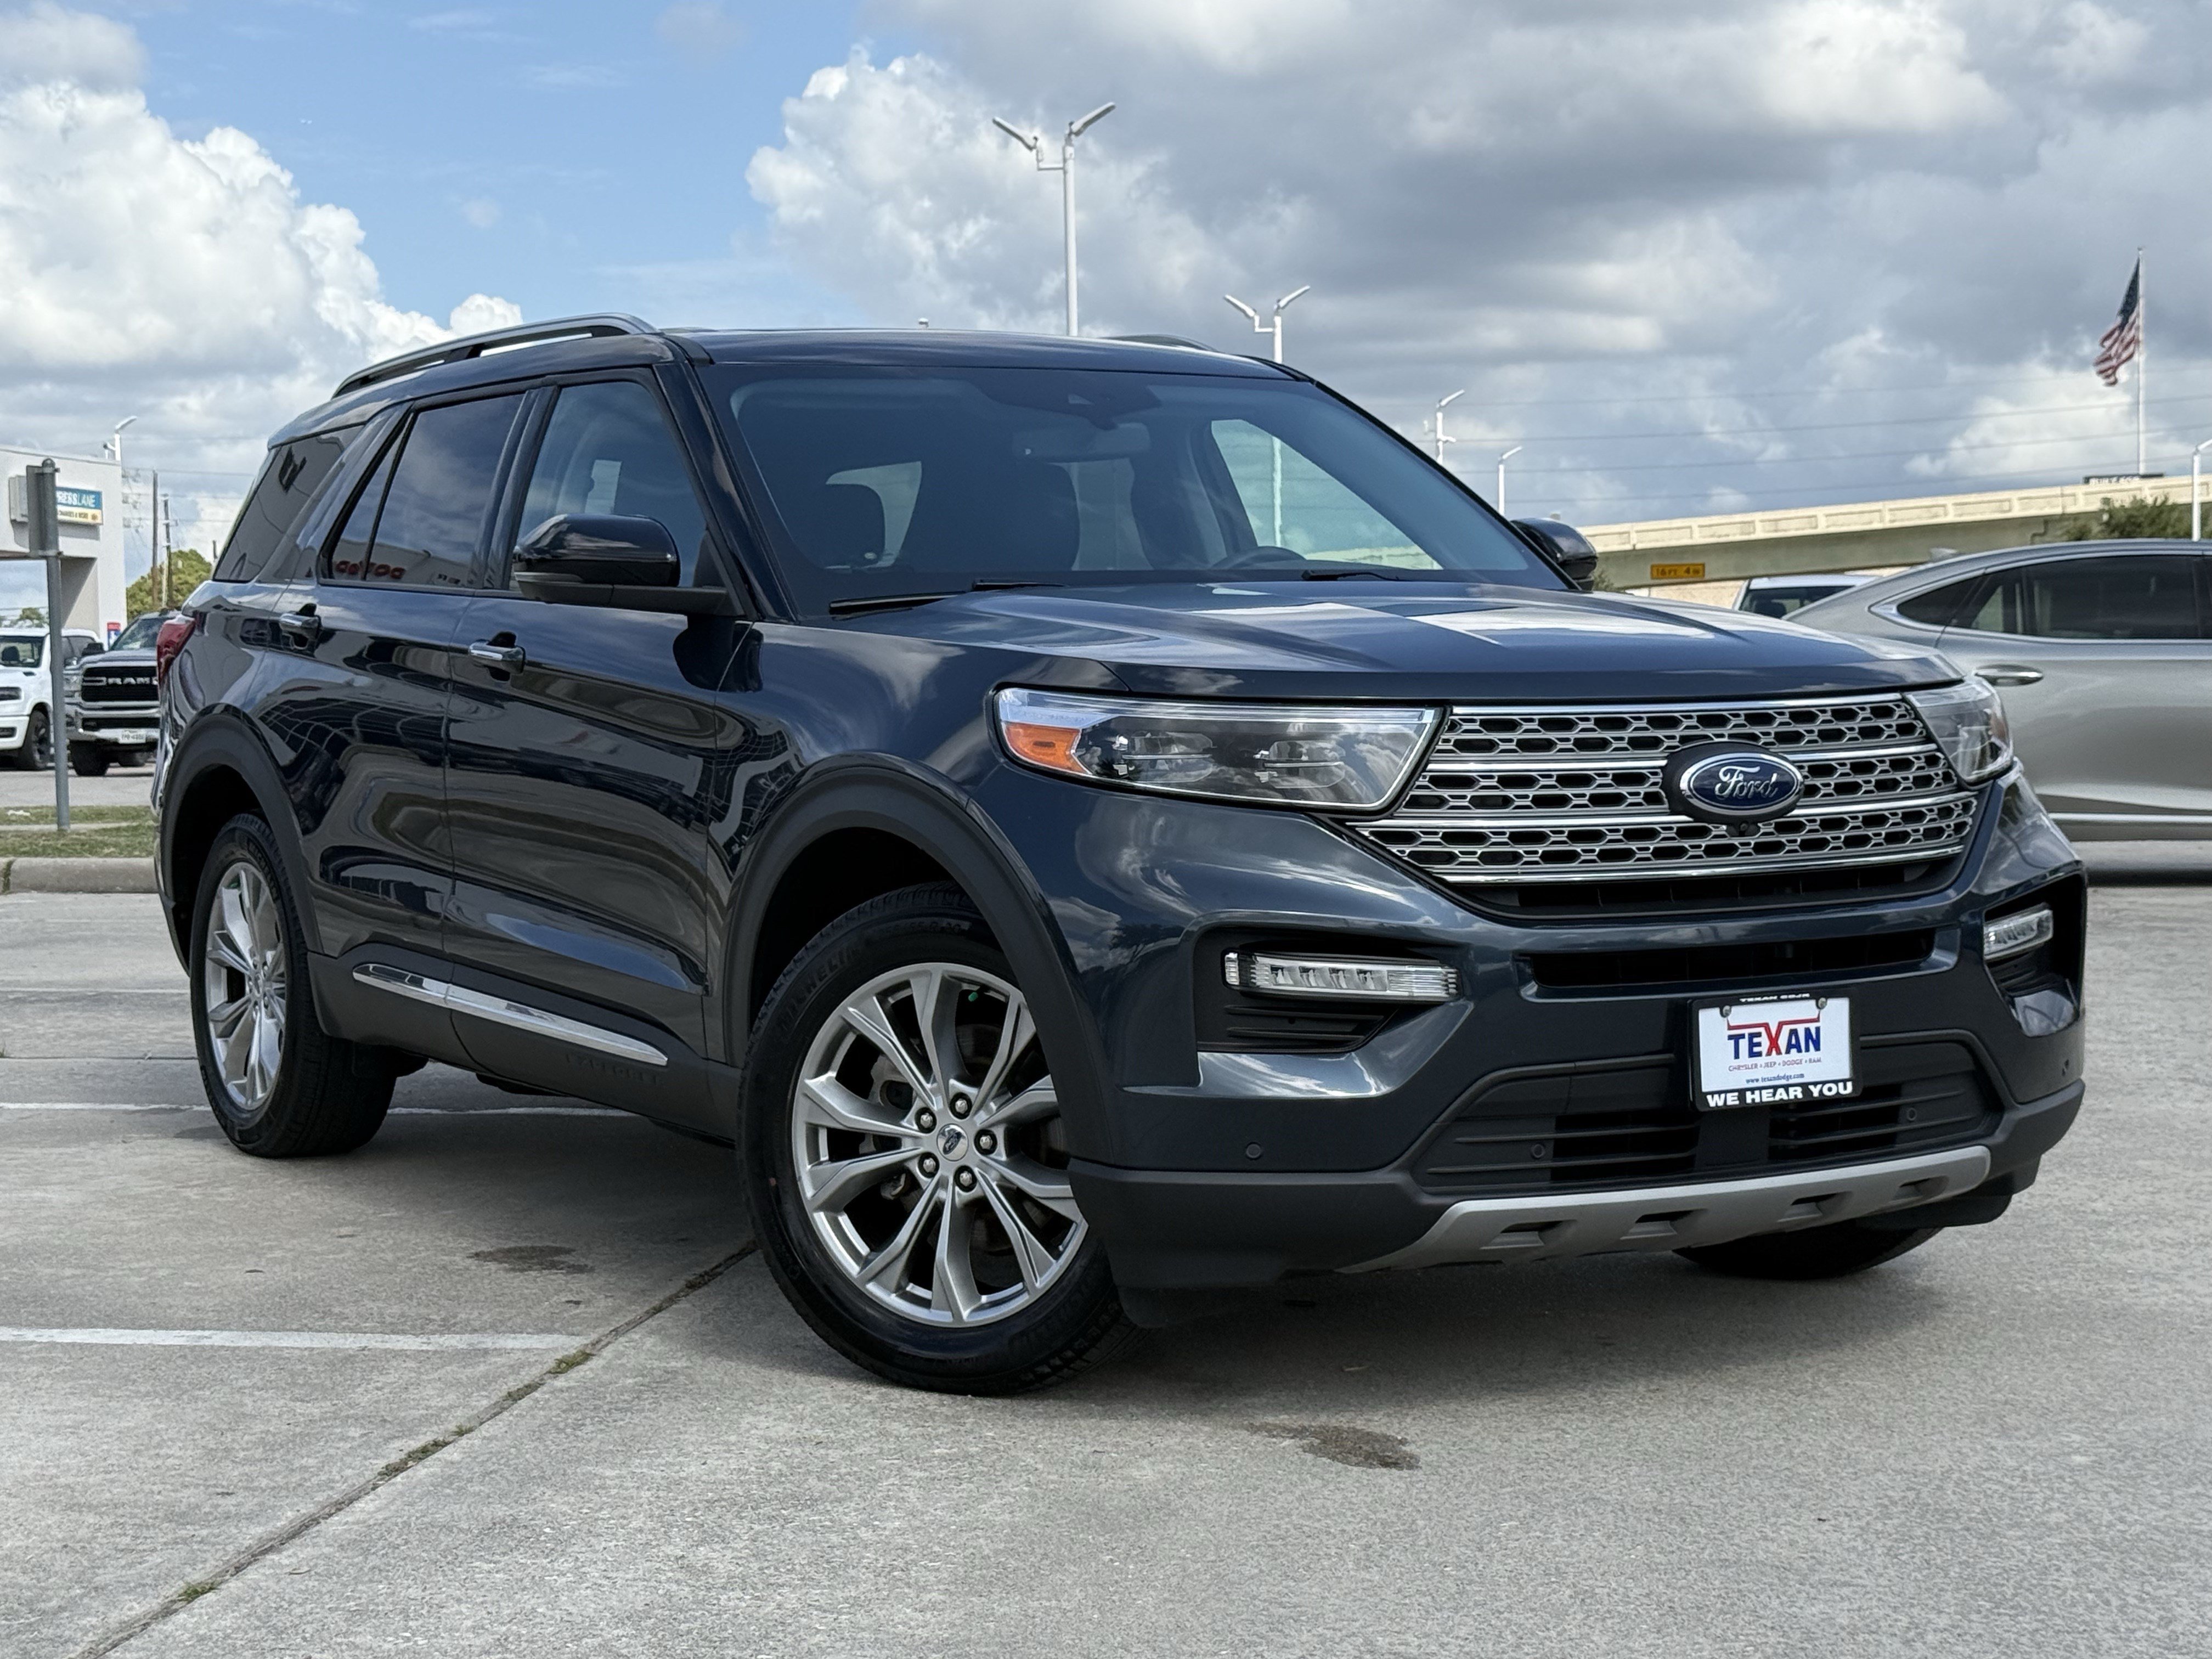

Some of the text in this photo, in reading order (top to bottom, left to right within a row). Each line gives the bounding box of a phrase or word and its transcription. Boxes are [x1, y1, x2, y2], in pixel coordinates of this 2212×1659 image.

[1714, 765, 1779, 799] Ford
[1727, 1019, 1821, 1060] TEXAN
[1706, 1081, 1853, 1107] WE HEAR YOU
